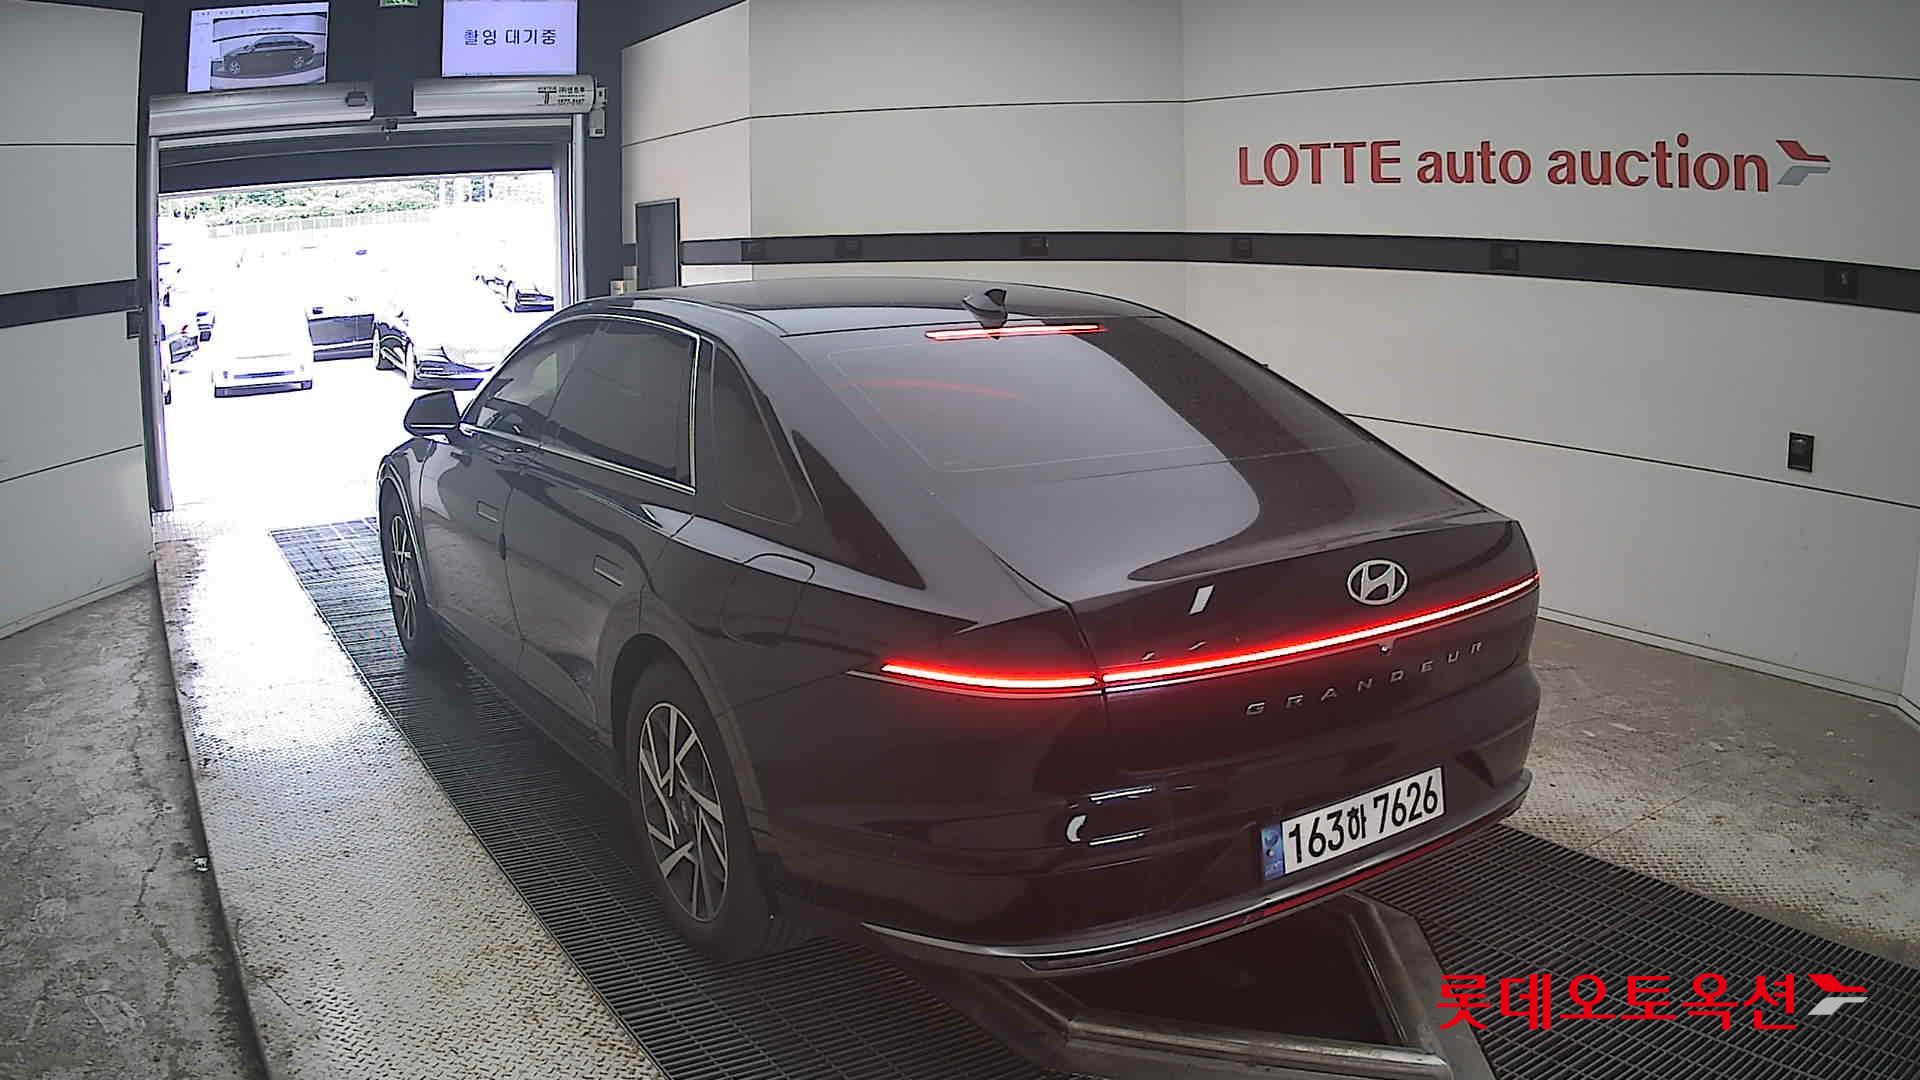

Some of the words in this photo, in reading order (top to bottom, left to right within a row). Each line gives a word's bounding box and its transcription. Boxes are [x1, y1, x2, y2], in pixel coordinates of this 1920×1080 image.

[505, 29, 557, 46] 대기중
[1238, 140, 1402, 187] LOTTE
[1416, 140, 1532, 185] auto
[1547, 133, 1770, 193] auction
[1246, 640, 1483, 716] GRANDEUR
[1288, 804, 1368, 864] 163하
[1372, 775, 1439, 834] 7626
